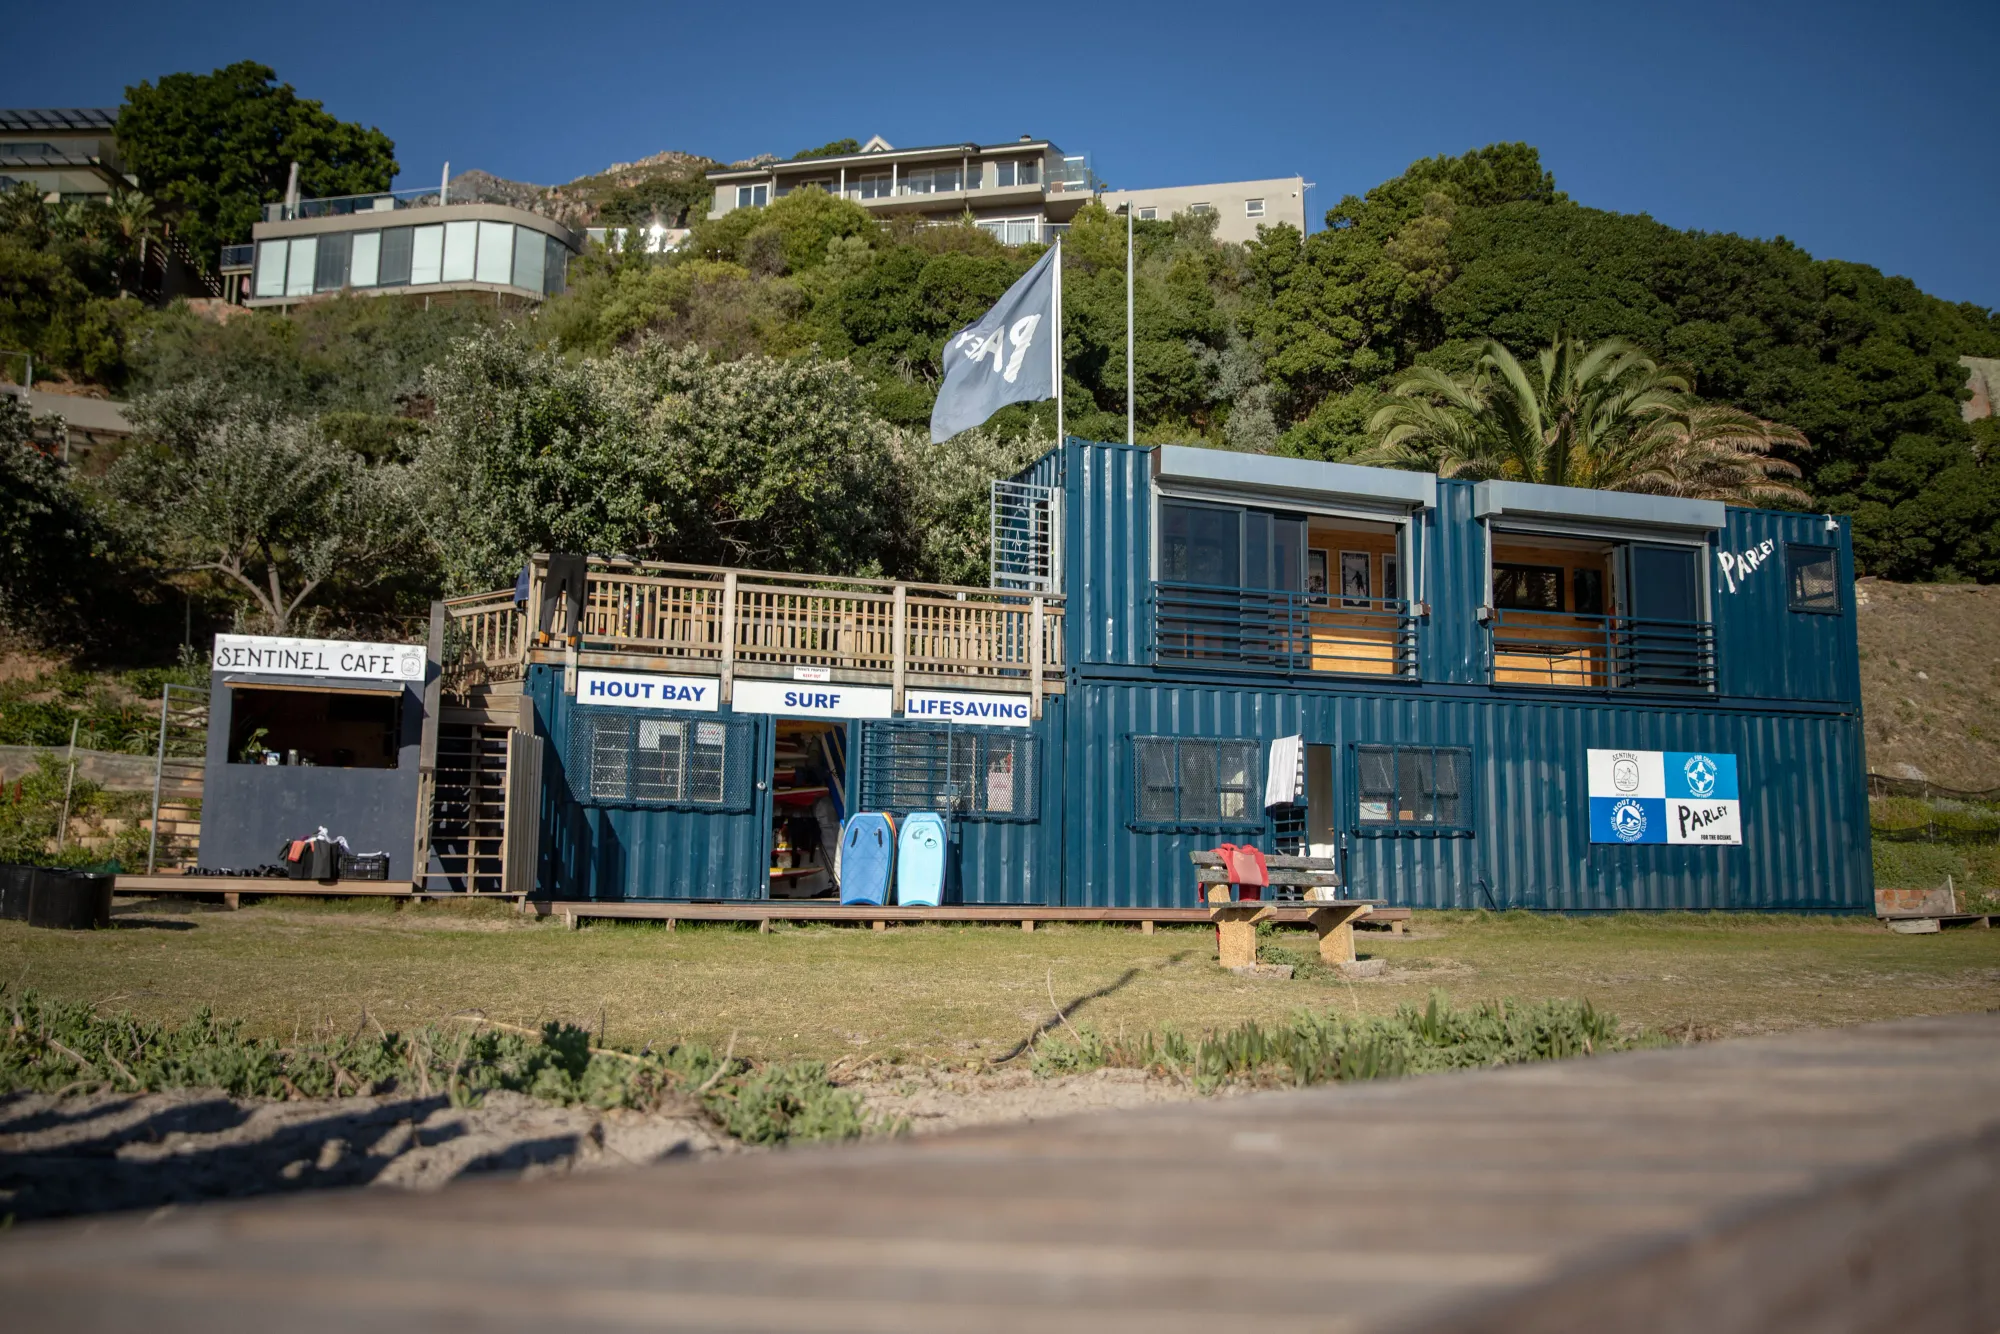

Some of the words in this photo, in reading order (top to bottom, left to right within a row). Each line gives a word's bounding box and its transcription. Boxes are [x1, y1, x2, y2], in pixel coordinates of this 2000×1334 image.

[1717, 538, 1775, 594] PARLEY
[217, 647, 329, 670] SENTINEL
[341, 654, 394, 674] CAFE
[590, 680, 655, 698] HOUT
[662, 685, 706, 702] BAY
[784, 692, 841, 709] SURF
[908, 699, 1028, 718] LIFESAVING
[1612, 752, 1638, 762] SENTINEL
[1613, 799, 1630, 812] HOUT
[1632, 799, 1644, 812] BAY
[1678, 805, 1728, 838] PARLEY
[1616, 831, 1643, 843] LIFESAVING
